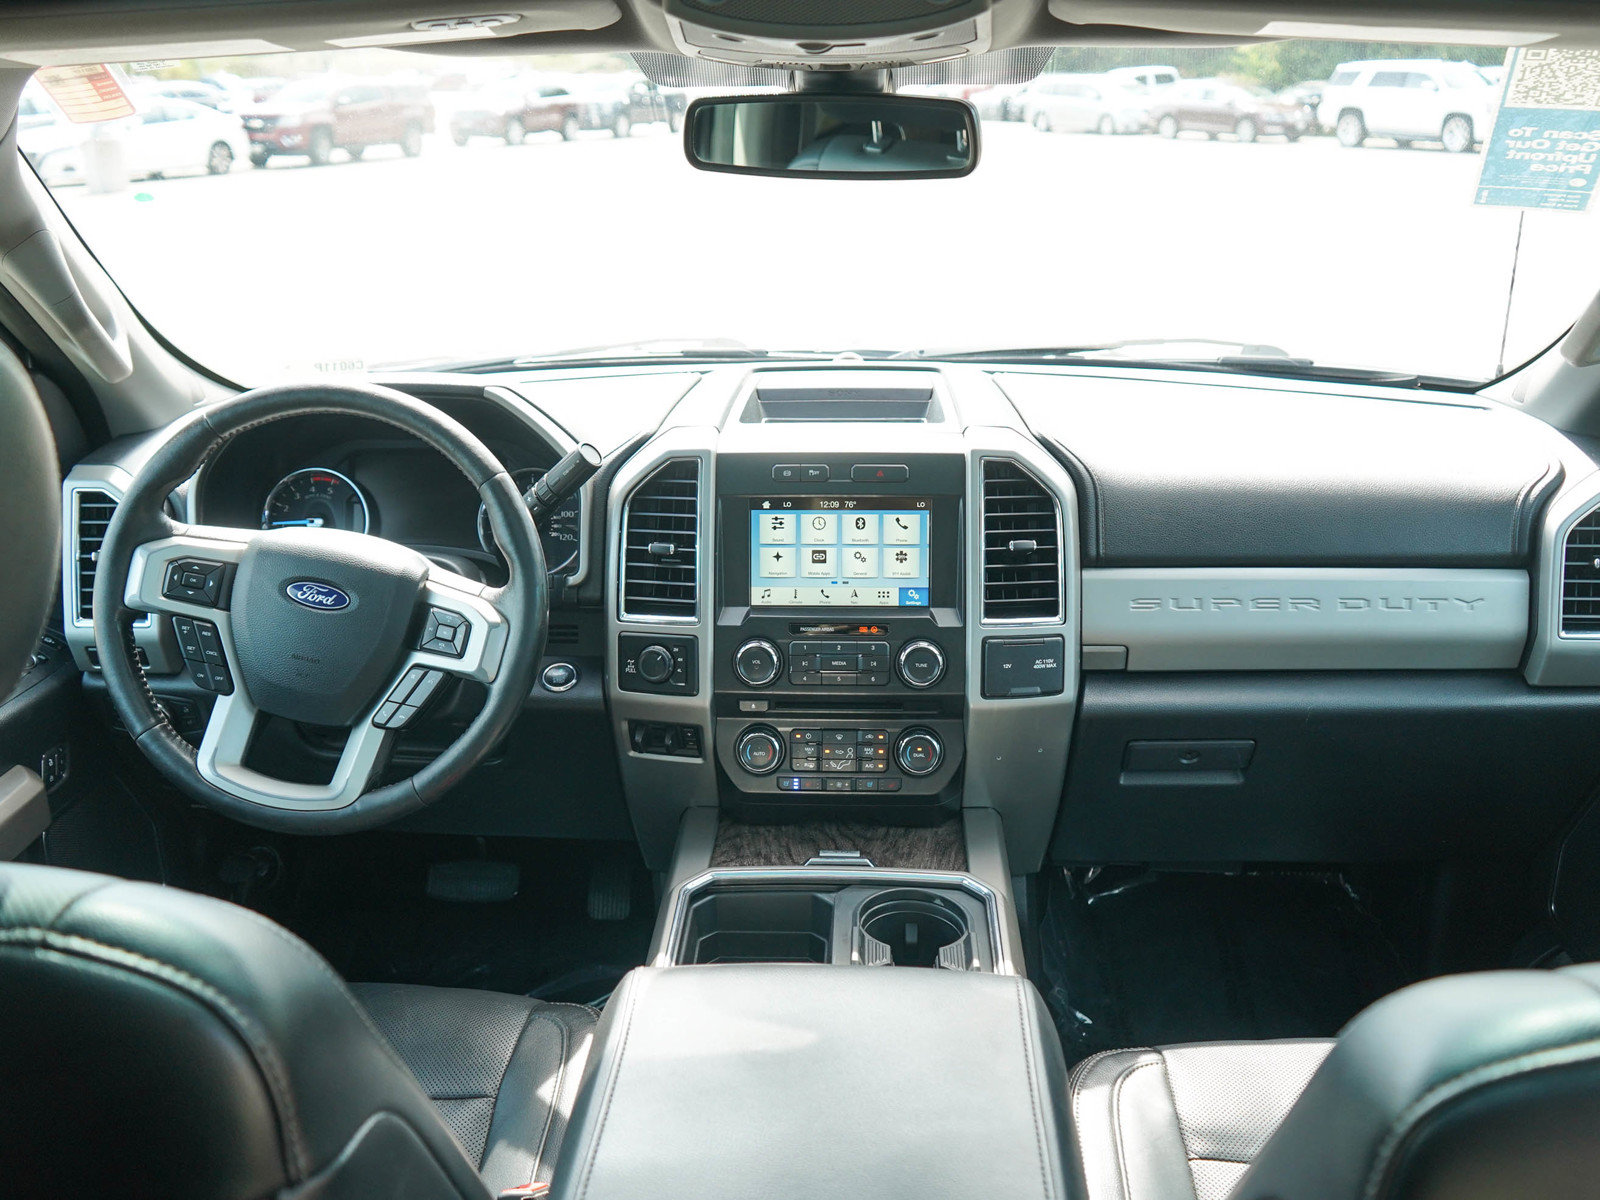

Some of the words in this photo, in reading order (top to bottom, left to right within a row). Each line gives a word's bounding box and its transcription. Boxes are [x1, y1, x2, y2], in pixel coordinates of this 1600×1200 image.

[298, 584, 337, 605] Ford
[1130, 597, 1320, 612] SUPER
[1337, 597, 1485, 612] DUTY
